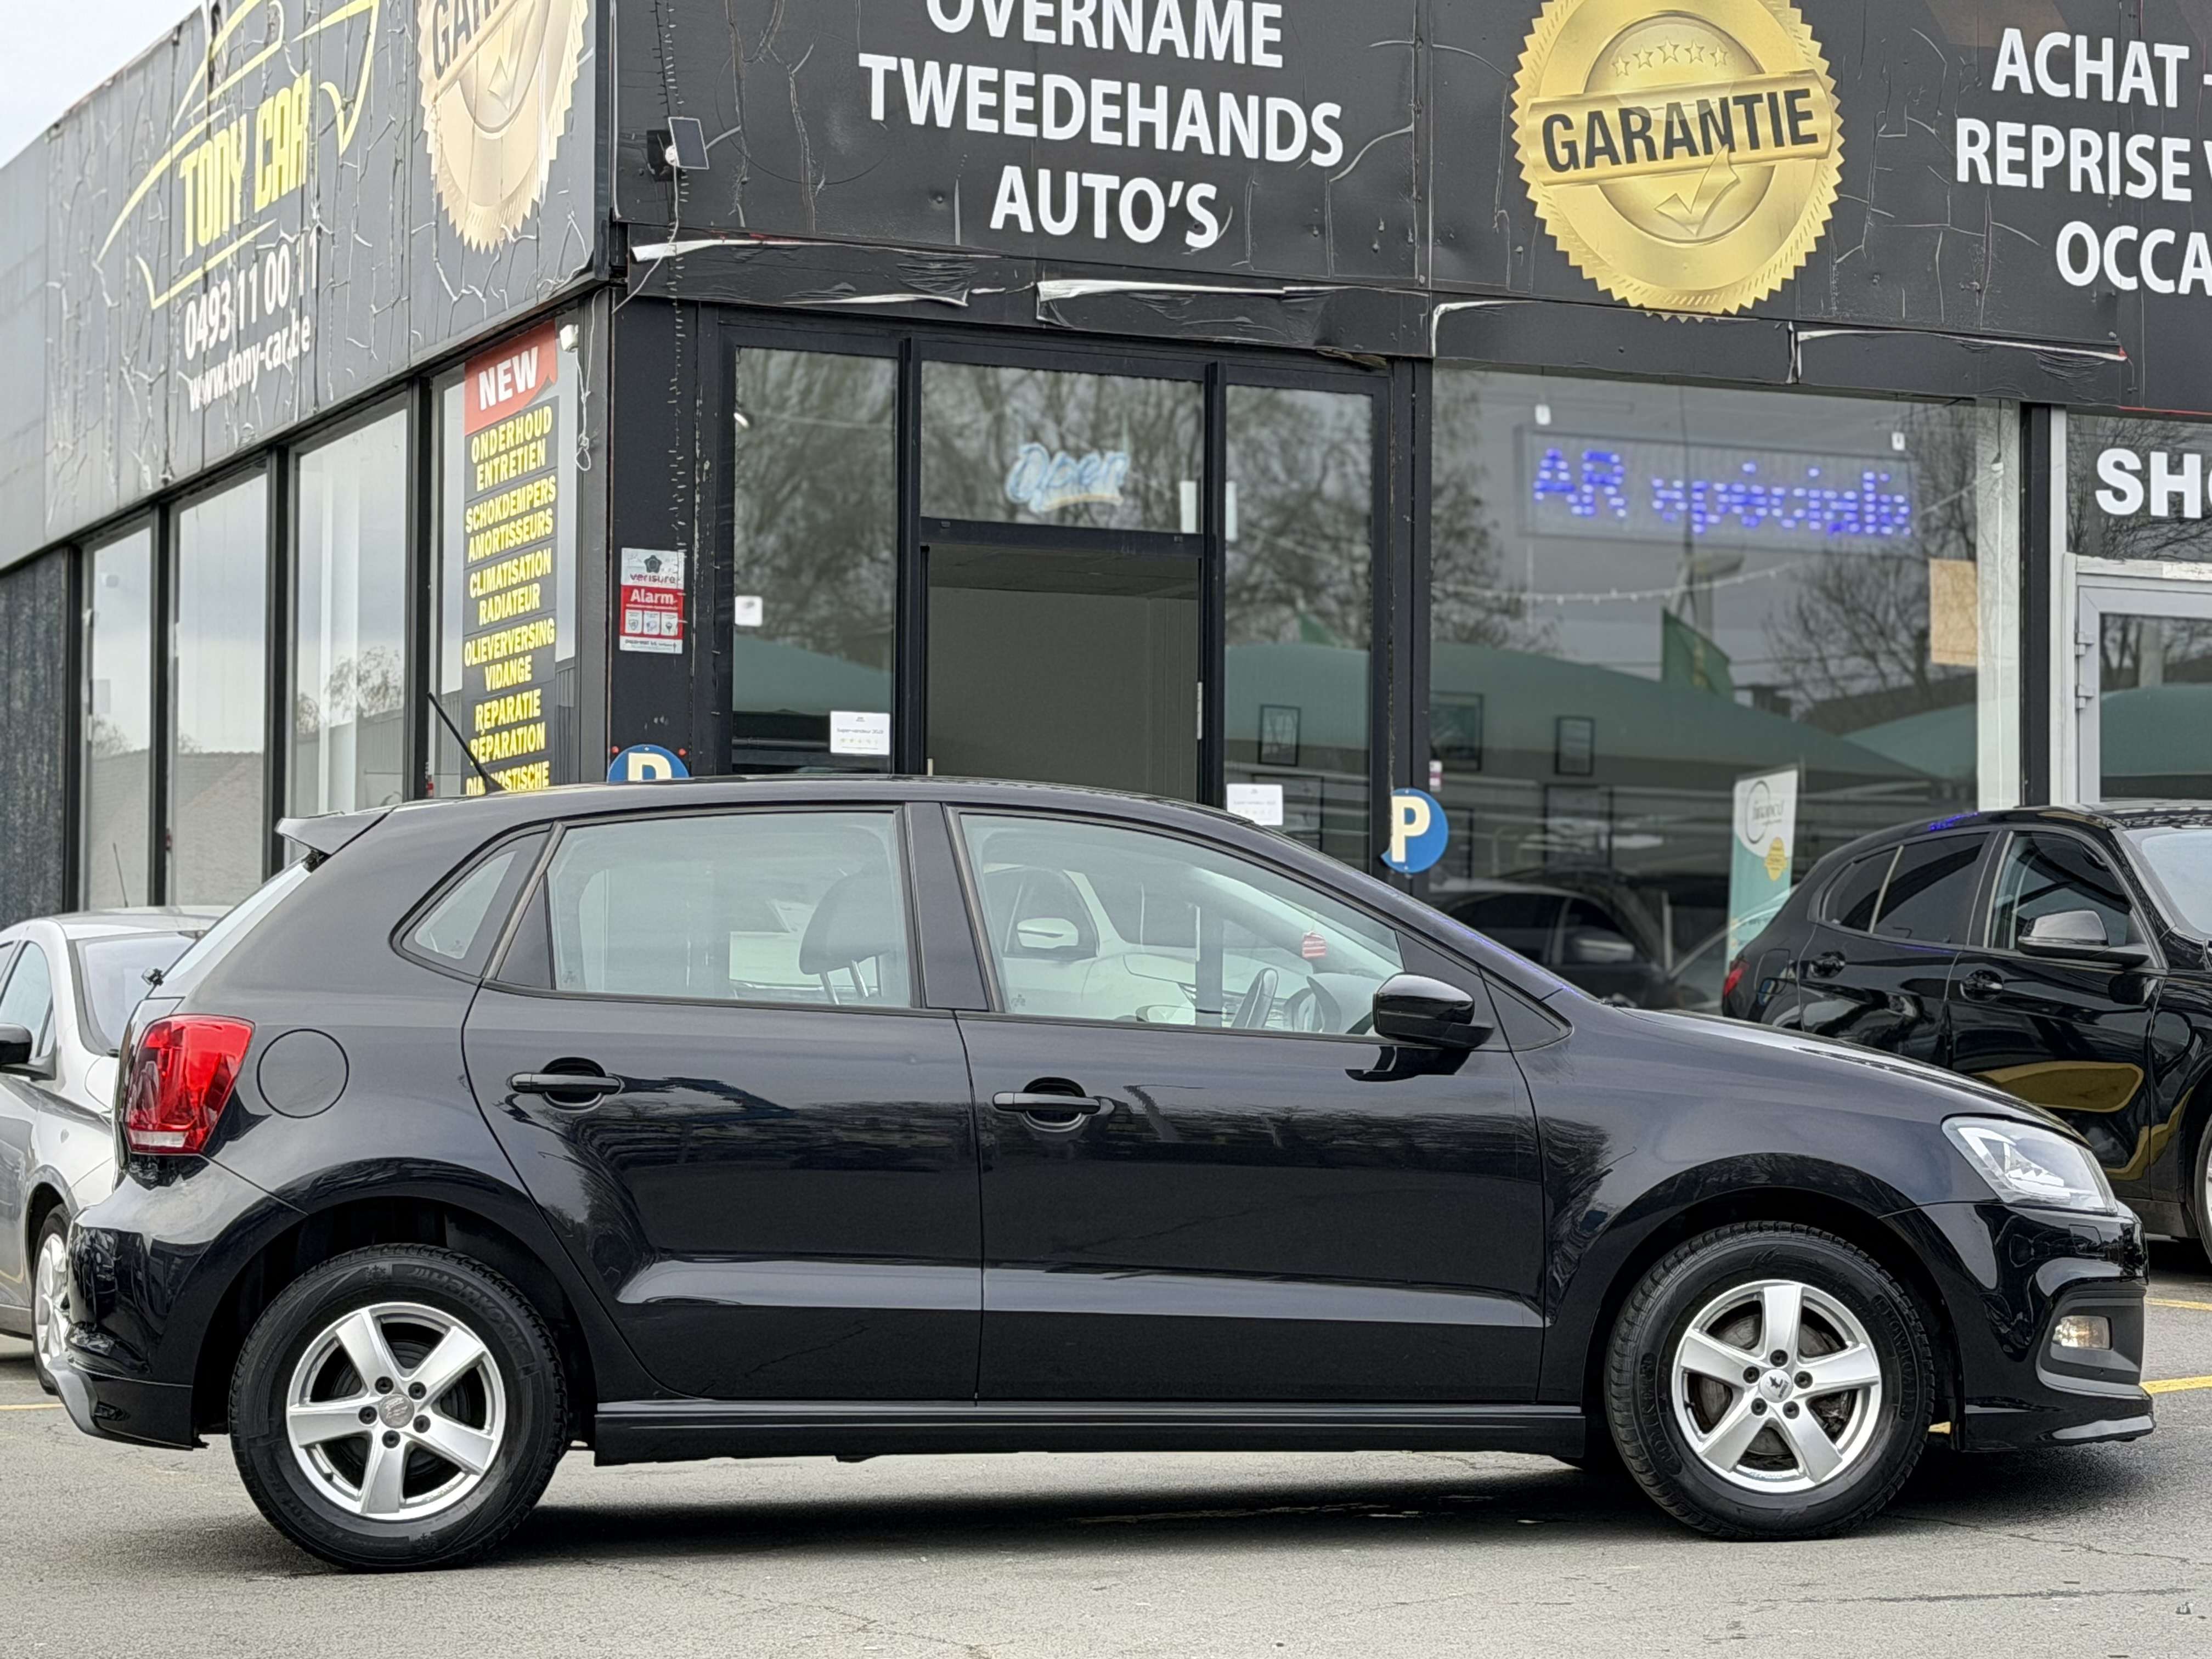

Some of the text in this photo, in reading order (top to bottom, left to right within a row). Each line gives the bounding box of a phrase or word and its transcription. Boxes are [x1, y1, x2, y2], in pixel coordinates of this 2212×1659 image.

[1991, 27, 2190, 108] ACHAT
[859, 53, 1344, 167] TWEEDEHANDS
[1542, 87, 1819, 173] GARANTIE
[178, 69, 311, 258] TONY CAR
[1956, 118, 2192, 202] REPRISE
[989, 165, 1219, 249] AUTO'S
[184, 227, 317, 361] 0493 11 00 11
[190, 307, 311, 412] www.tony-car.be
[478, 346, 539, 411] NEW
[471, 405, 552, 464] ONDERHOUD
[476, 438, 546, 492] ENTRETIEN
[465, 475, 556, 534] SCHOKDEMPERS
[2095, 447, 2212, 519] SH
[467, 508, 554, 563] AMORTISSEURS
[469, 548, 552, 599] CLIMATISATION
[478, 583, 541, 626] RADIATEUR
[630, 588, 674, 605] Alarm
[464, 617, 555, 668] OLIEVERVERSING
[484, 655, 532, 692] VIDANGE
[475, 689, 541, 732] REPARATIE
[1391, 795, 1431, 863] P
